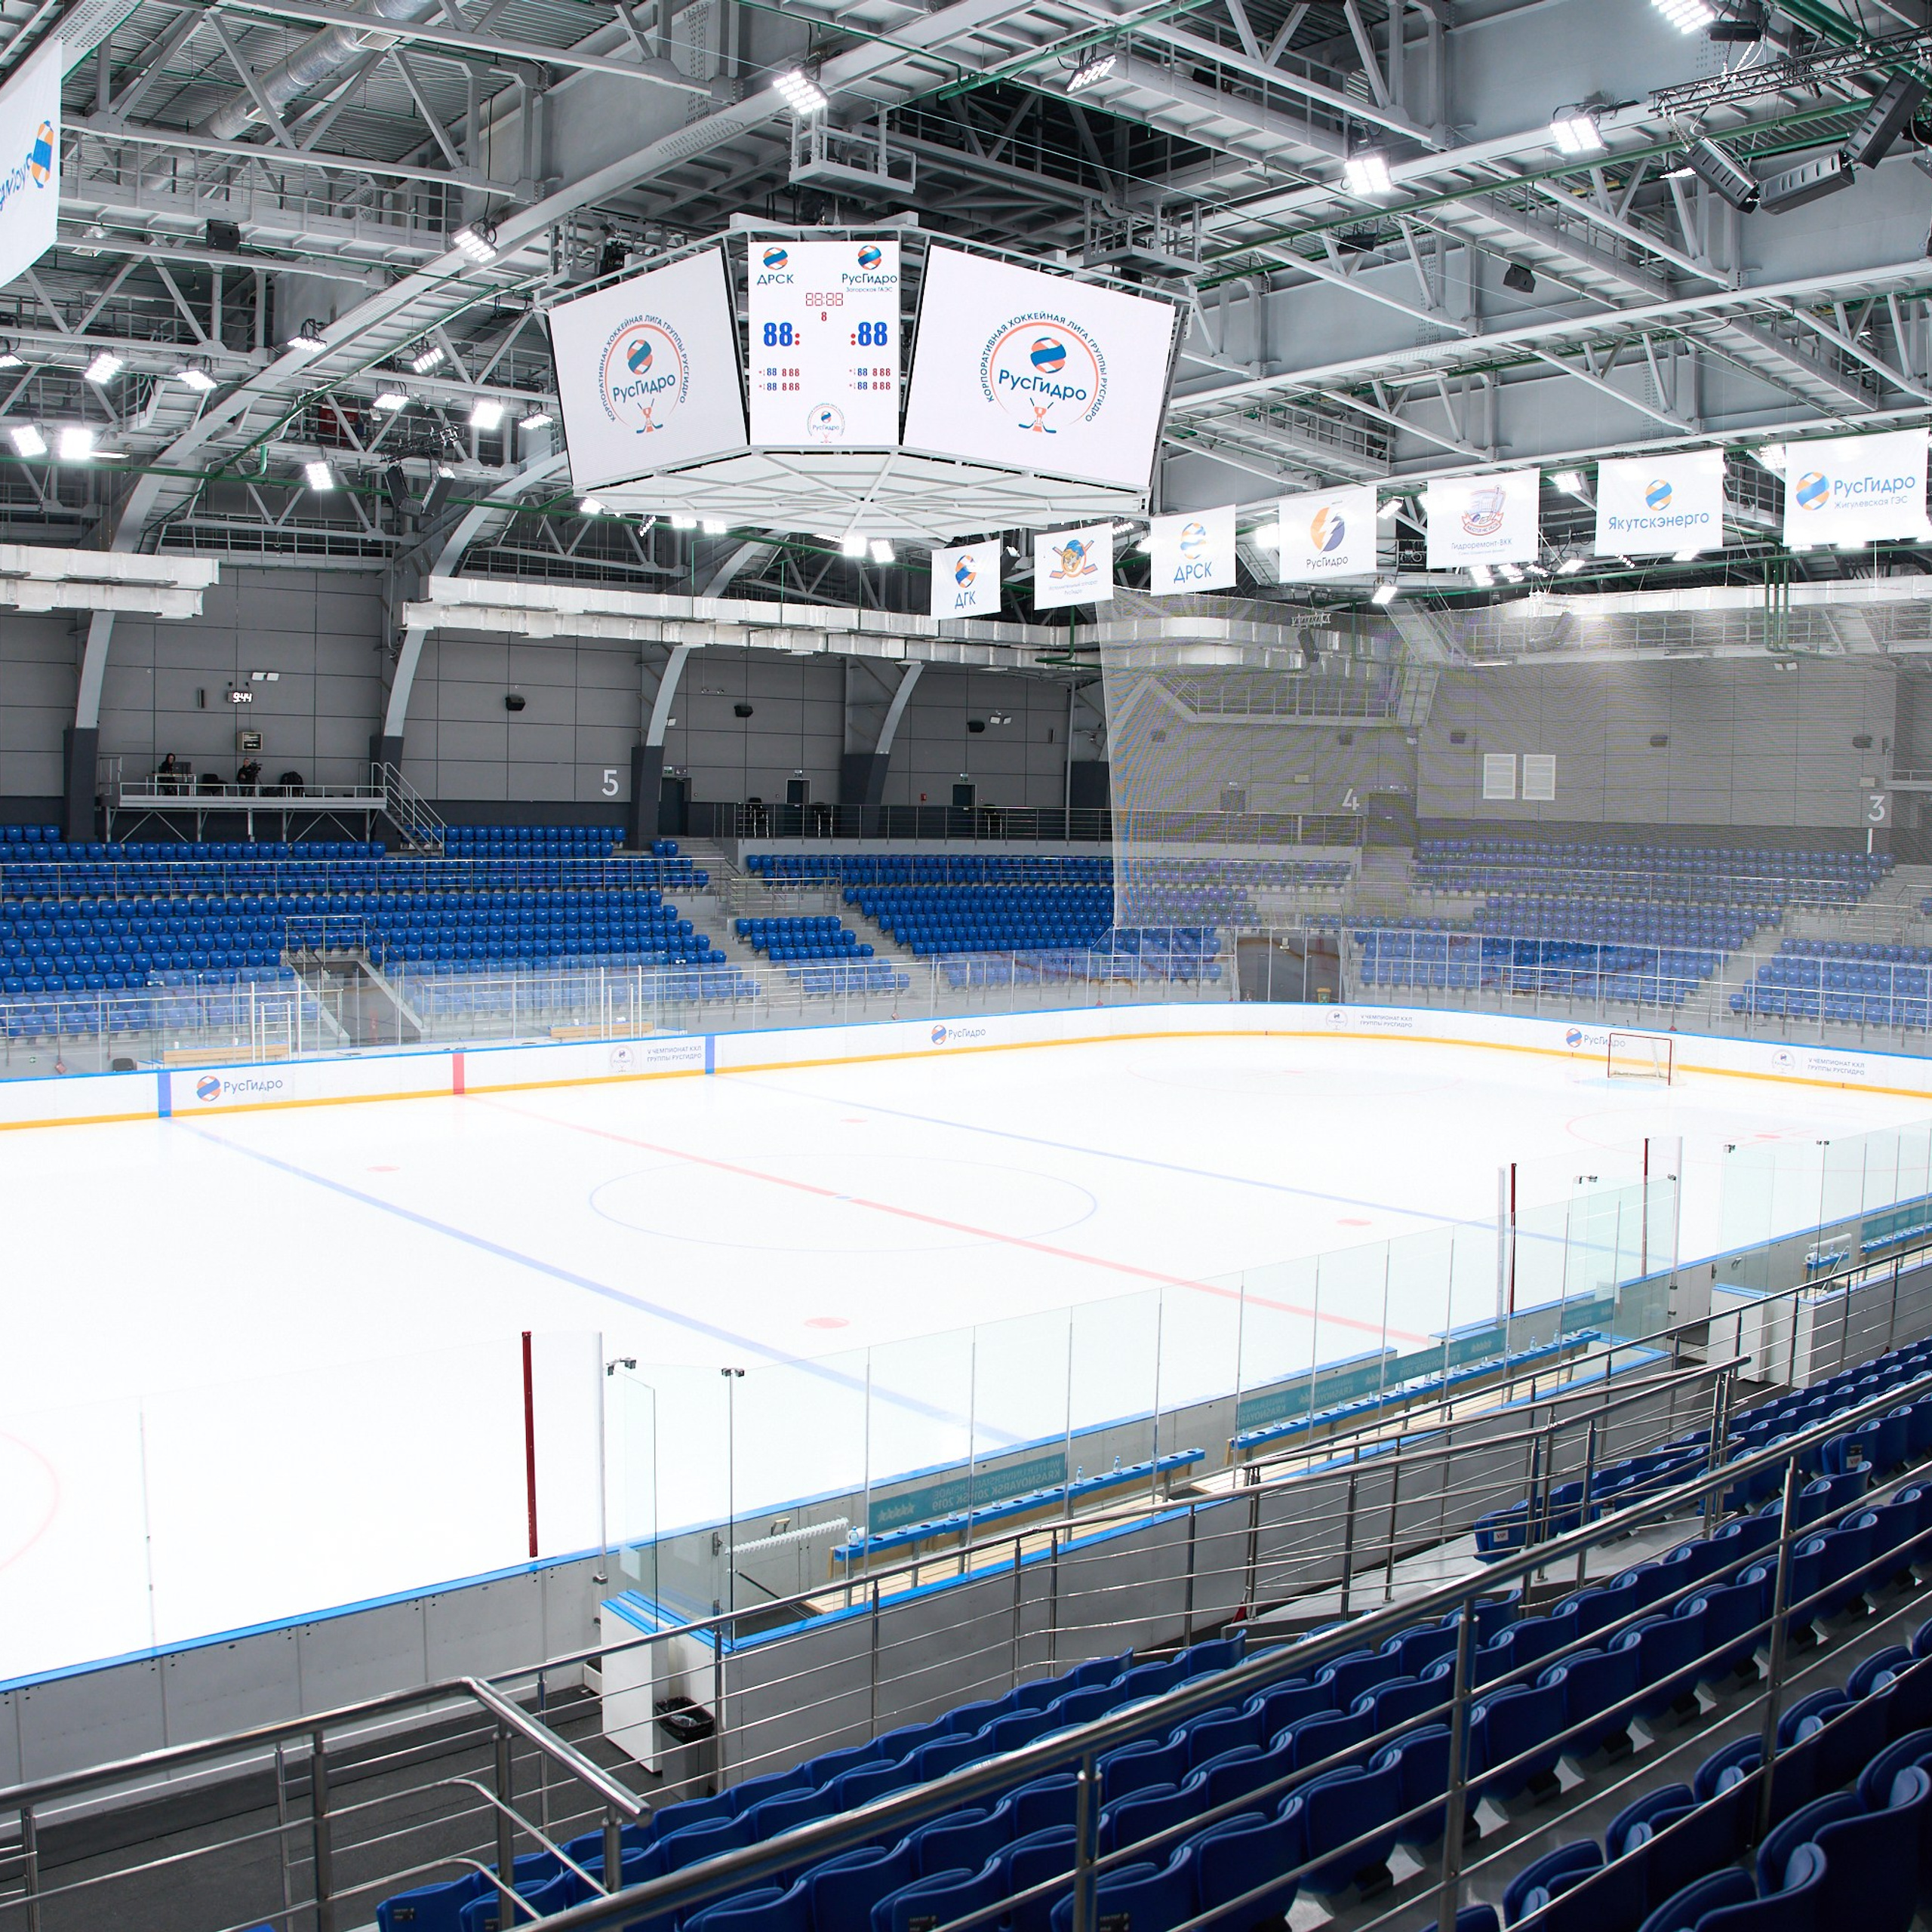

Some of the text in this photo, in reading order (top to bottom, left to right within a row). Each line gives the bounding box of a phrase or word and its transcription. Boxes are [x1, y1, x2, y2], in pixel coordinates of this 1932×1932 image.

[757, 274, 794, 285] ДРСК
[842, 273, 897, 285] РусГидро
[821, 312, 827, 321] 8
[598, 315, 690, 422] КОРПОРАТИВНАЯ ХОККЕЙНАЯ ЛИГА ГРУППЫ РУСГИДРО
[980, 311, 1108, 422] КОРПОРАТИВНАЯ ХОККЕЙНАЯ ЛИГА ГРУППЫ РУСГИДРО
[613, 374, 675, 404] РусГидро
[998, 369, 1087, 401] РусГидро
[1834, 476, 1915, 498] РусГидро
[1835, 495, 1908, 509] Жигулевская ГЭС
[1608, 512, 1709, 532] Якутскэнерго
[1174, 561, 1212, 583] ДРСК
[1306, 556, 1349, 571] РусГидро
[955, 591, 976, 609] ДГК
[601, 770, 619, 796] 5
[1342, 788, 1360, 811] 4
[1868, 795, 1885, 821] 3
[949, 1029, 986, 1040] РусГидро
[652, 1046, 688, 1054] ЧЕМПИОНАТ
[1832, 1067, 1865, 1075] РУСГИДРО
[224, 1080, 283, 1094] РусГидро
